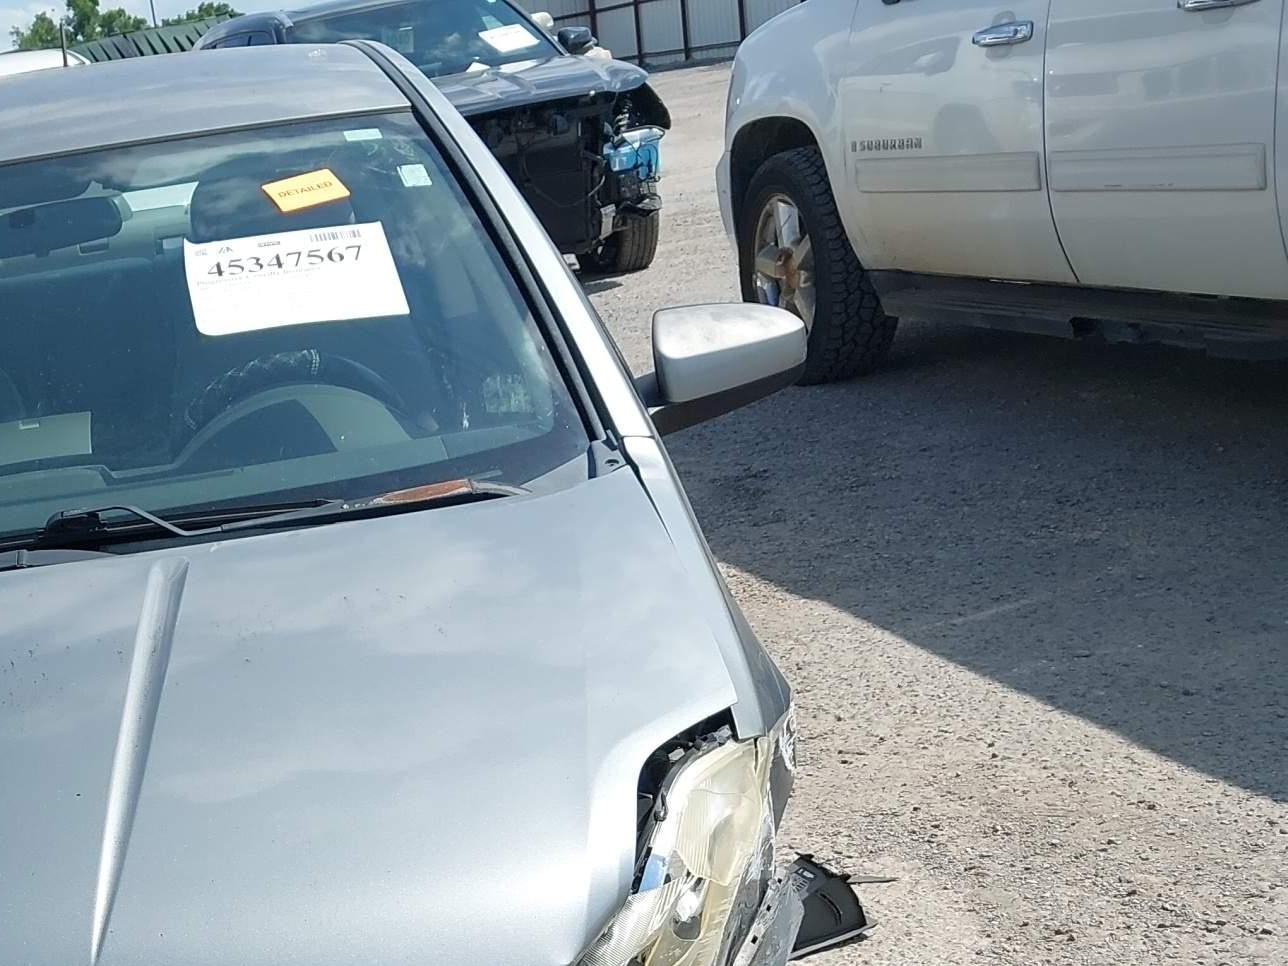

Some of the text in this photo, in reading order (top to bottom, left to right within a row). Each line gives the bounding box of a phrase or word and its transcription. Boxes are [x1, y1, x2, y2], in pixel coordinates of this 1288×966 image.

[858, 137, 922, 152] SUBURBAN
[277, 180, 334, 198] DETAILED
[207, 244, 363, 278] 45347567
